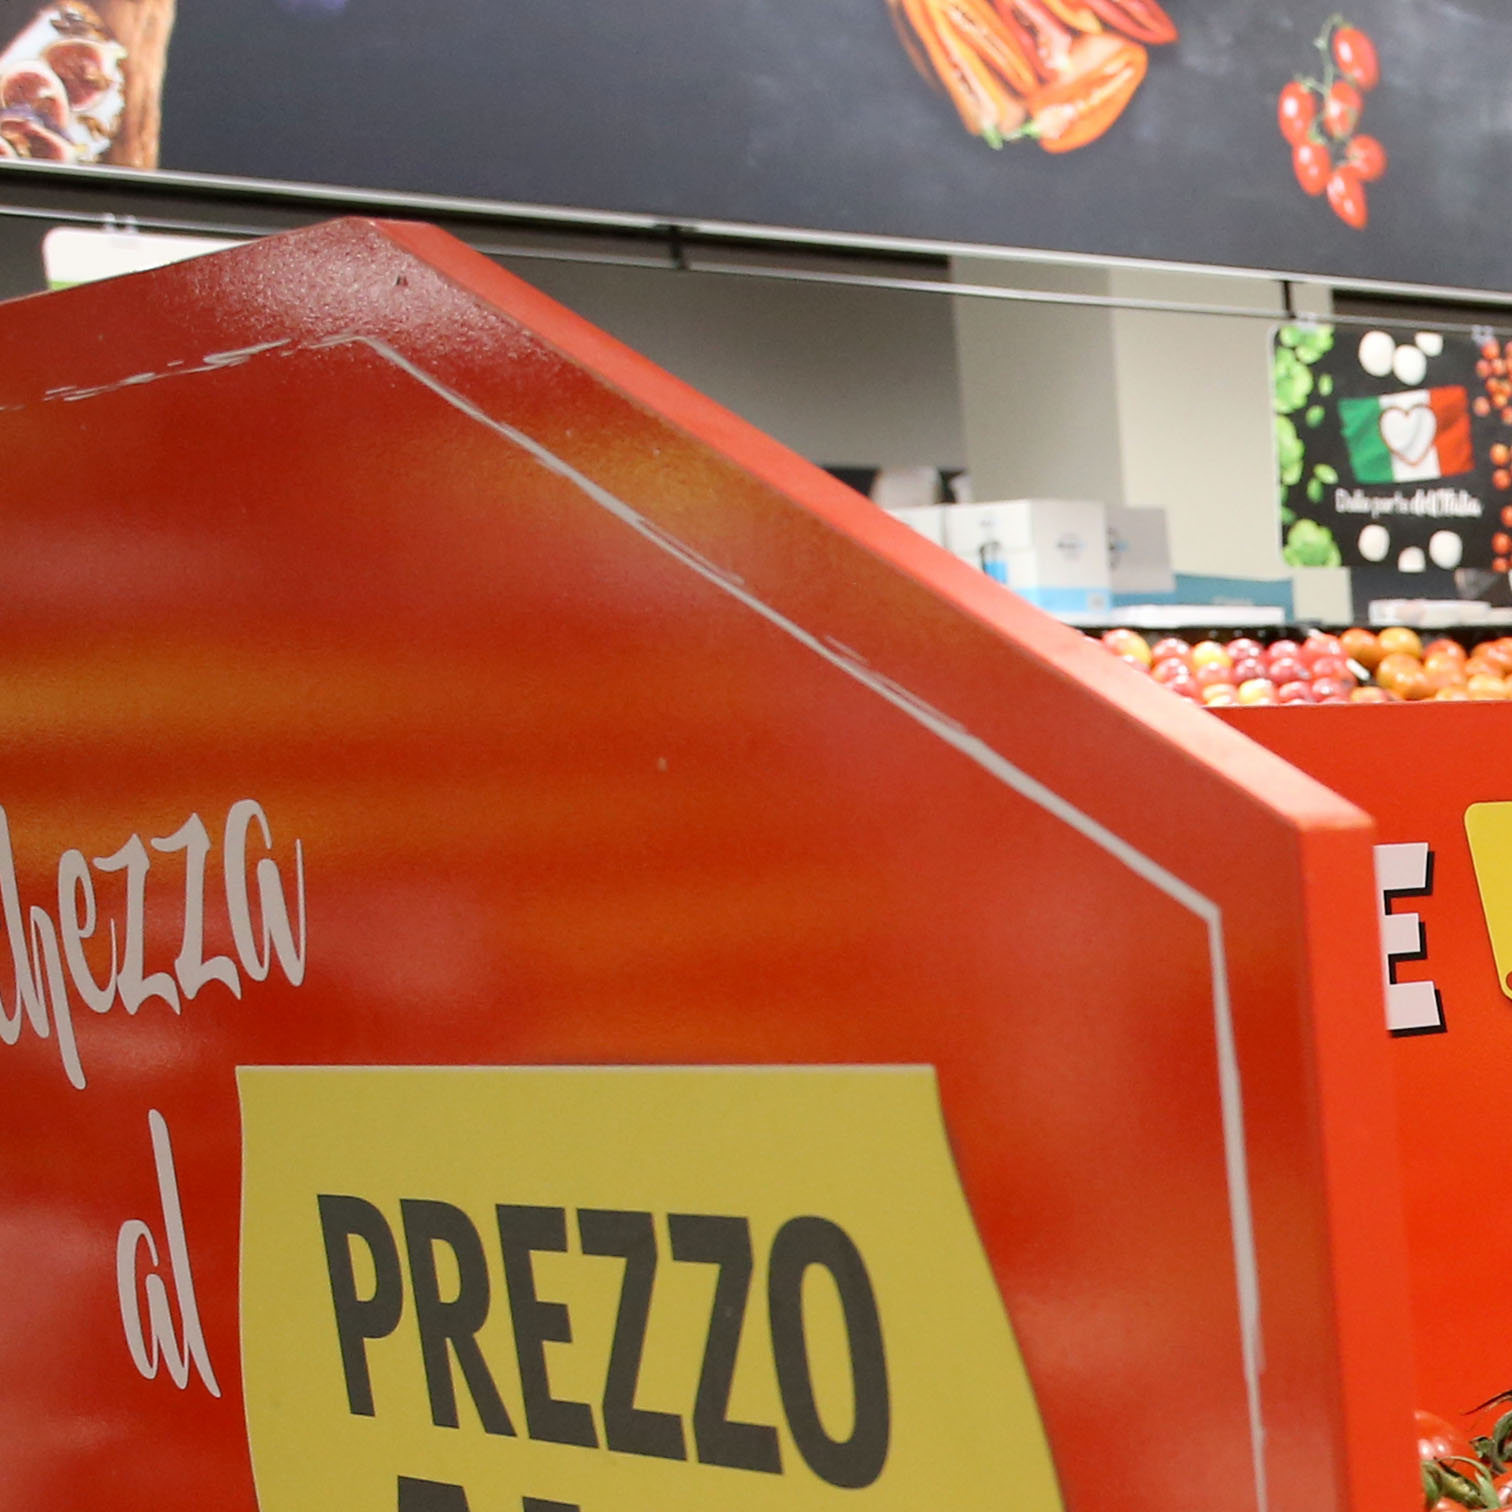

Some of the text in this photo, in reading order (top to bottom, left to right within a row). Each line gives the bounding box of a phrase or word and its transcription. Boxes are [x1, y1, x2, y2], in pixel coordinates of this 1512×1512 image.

[0, 799, 306, 1090] hezza
[115, 1110, 220, 1400] al
[316, 1192, 893, 1491] PREZZO
